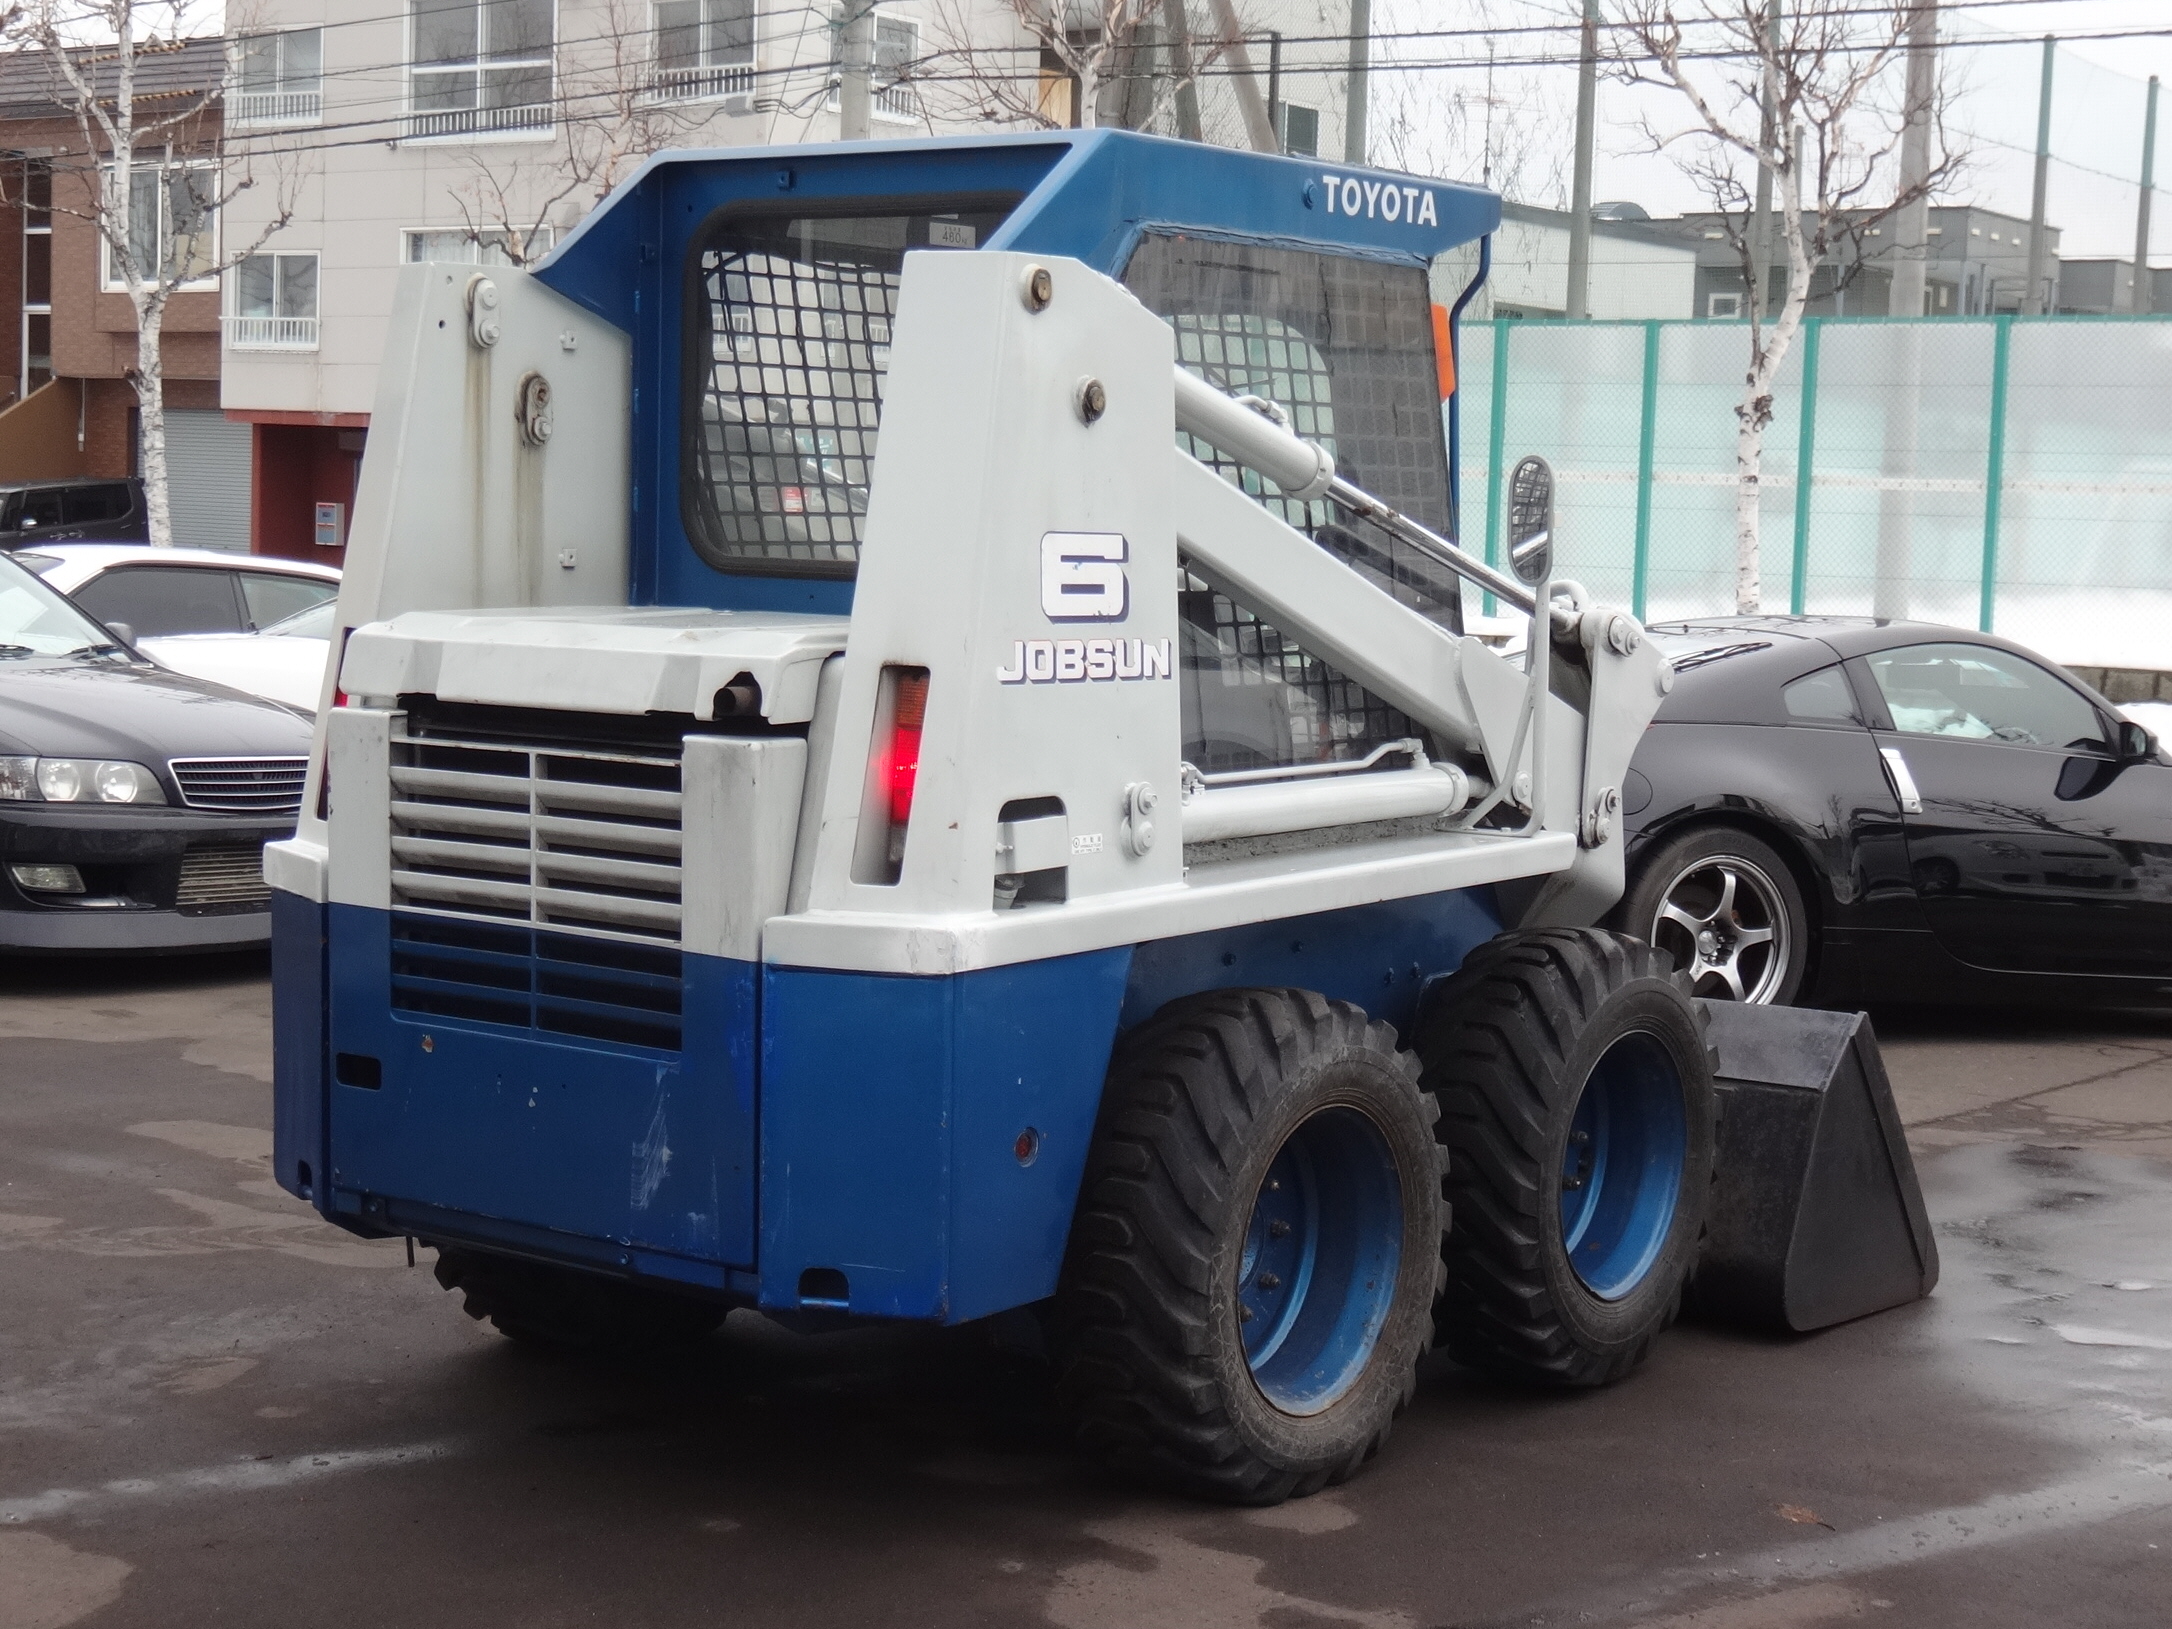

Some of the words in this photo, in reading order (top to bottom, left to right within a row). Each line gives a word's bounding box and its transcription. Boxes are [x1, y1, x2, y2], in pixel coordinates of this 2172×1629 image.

[1322, 175, 1437, 227] TOYOTA
[1040, 530, 1130, 624] 6
[996, 637, 1172, 685] JOBSUN
